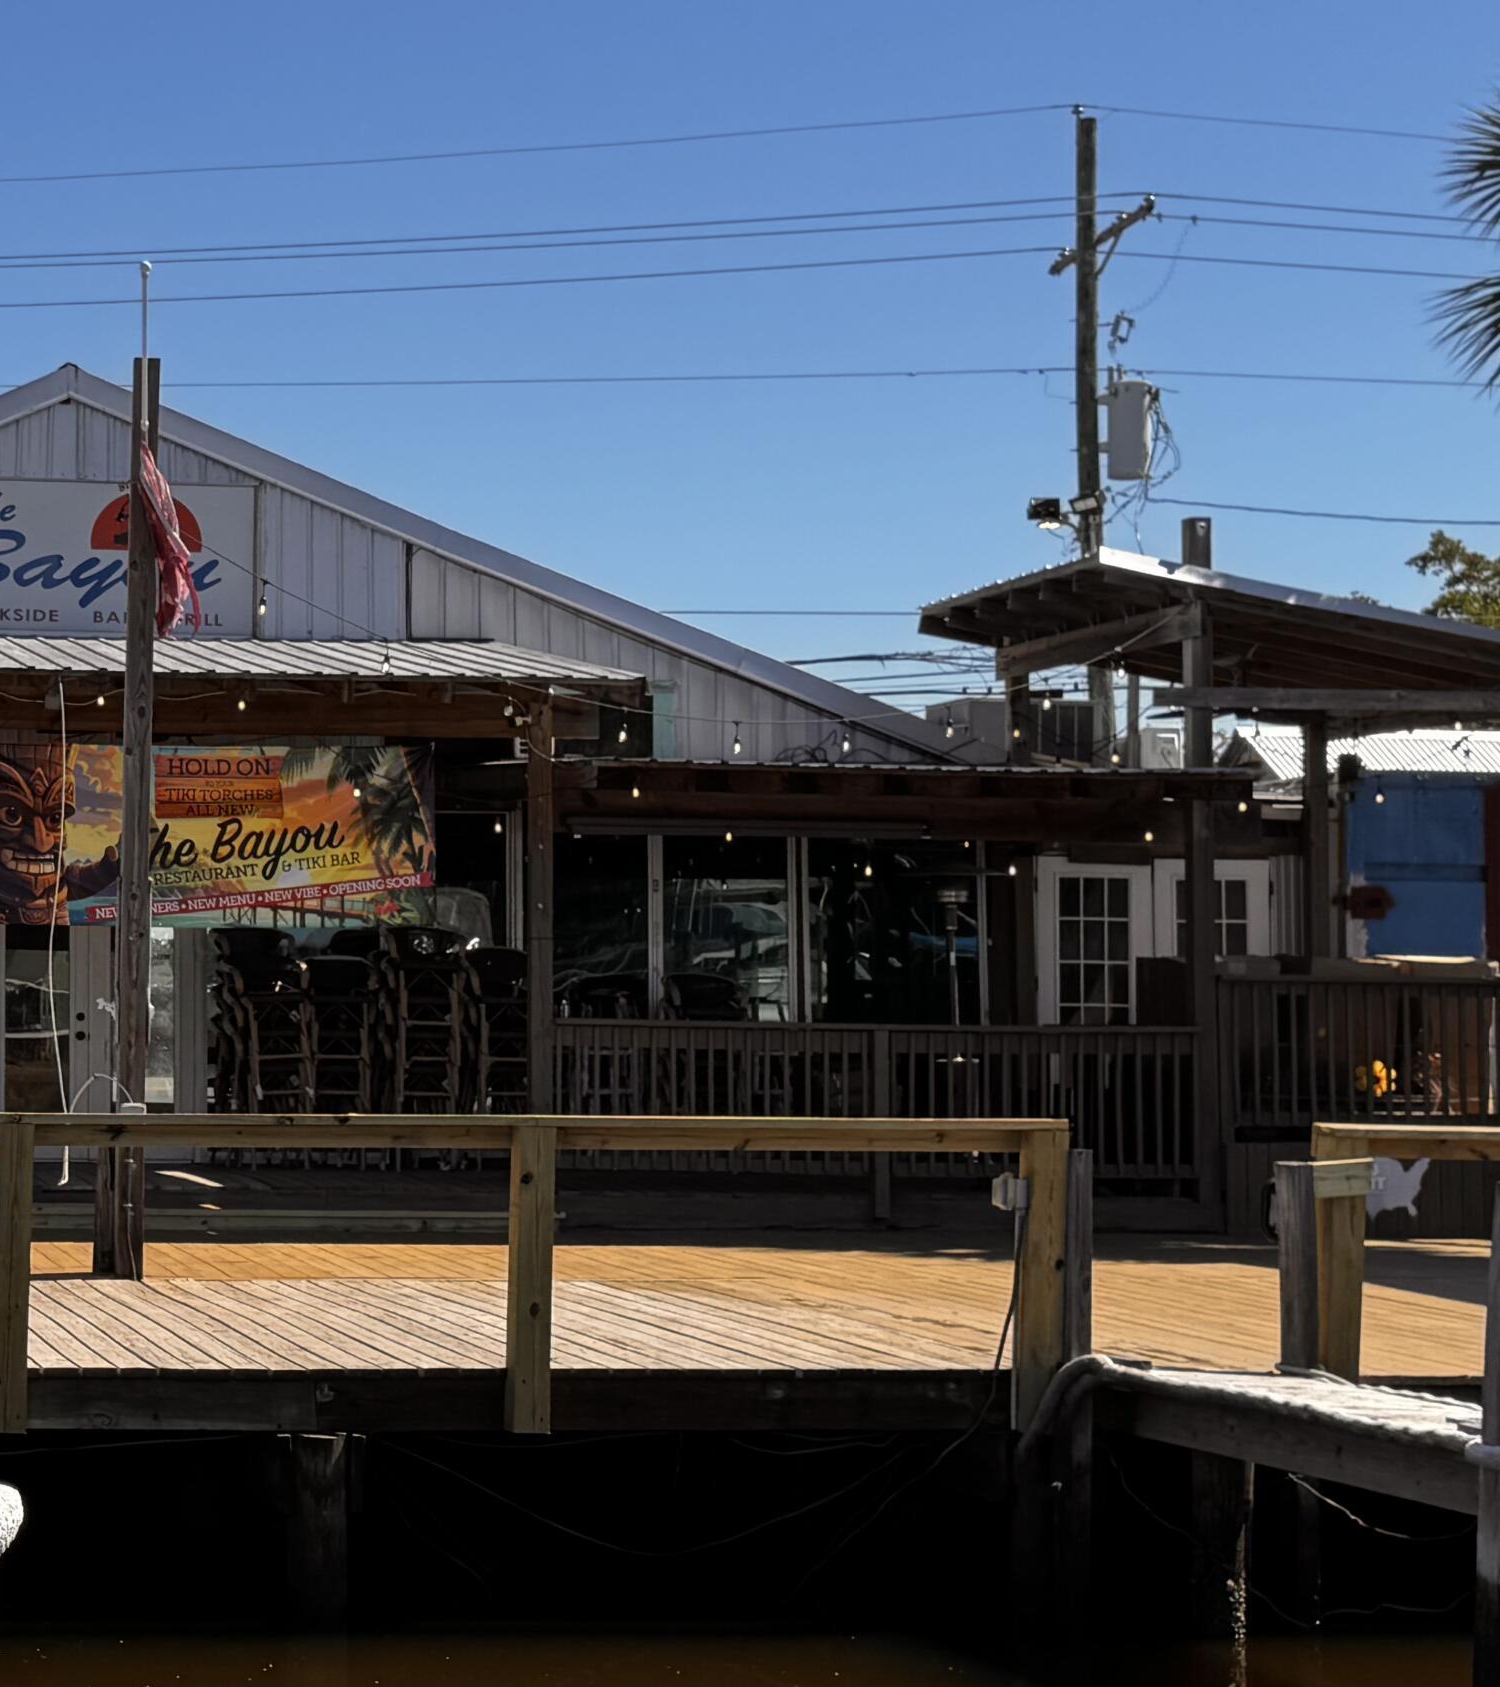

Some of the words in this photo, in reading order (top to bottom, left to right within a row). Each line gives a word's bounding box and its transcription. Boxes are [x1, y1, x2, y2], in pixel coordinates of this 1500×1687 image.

[166, 757, 232, 776] HOLD
[236, 758, 271, 776] ON
[165, 787, 197, 801] TIKI
[200, 788, 275, 801] TORCHES
[186, 804, 214, 817] ALL
[219, 803, 256, 817] NEW
[149, 823, 198, 872] he
[211, 817, 345, 881] Bayou
[153, 863, 258, 886] RESTAURANT
[281, 860, 292, 873] &
[295, 855, 328, 872] TIKI
[330, 851, 361, 869] BAR
[188, 899, 217, 911] NEW
[219, 893, 256, 908] MENU
[264, 889, 293, 903] NEW
[294, 886, 322, 899] VIBE
[329, 879, 385, 896] OPENING
[387, 874, 421, 889] SOON
